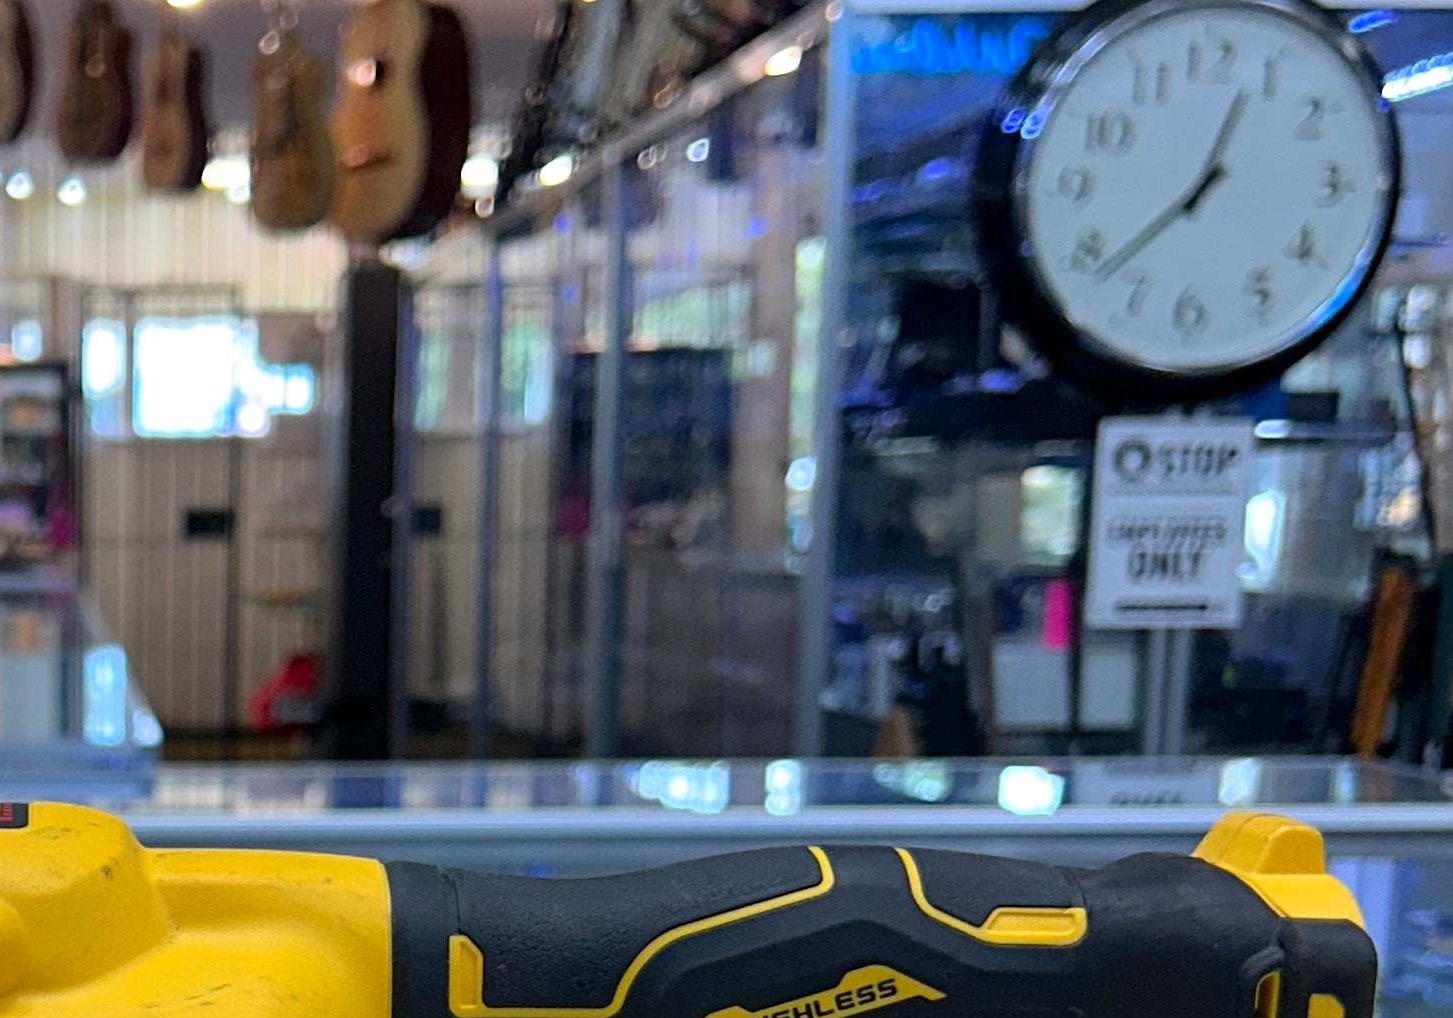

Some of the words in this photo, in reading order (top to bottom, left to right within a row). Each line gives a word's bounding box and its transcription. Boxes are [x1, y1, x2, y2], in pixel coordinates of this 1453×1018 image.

[1130, 56, 1172, 107] 11
[1186, 37, 1238, 85] 12
[1260, 46, 1281, 101] 1
[1085, 110, 1136, 156] 10
[1294, 96, 1327, 141] 2
[1057, 163, 1094, 208] 9
[1316, 158, 1347, 208] 3
[1068, 226, 1106, 274] 8
[1284, 219, 1322, 268] 4
[1120, 268, 1151, 320] 7
[1172, 285, 1210, 341] 6
[1246, 266, 1274, 326] 5
[1159, 441, 1239, 476] STOP
[1127, 549, 1204, 582] ONLY
